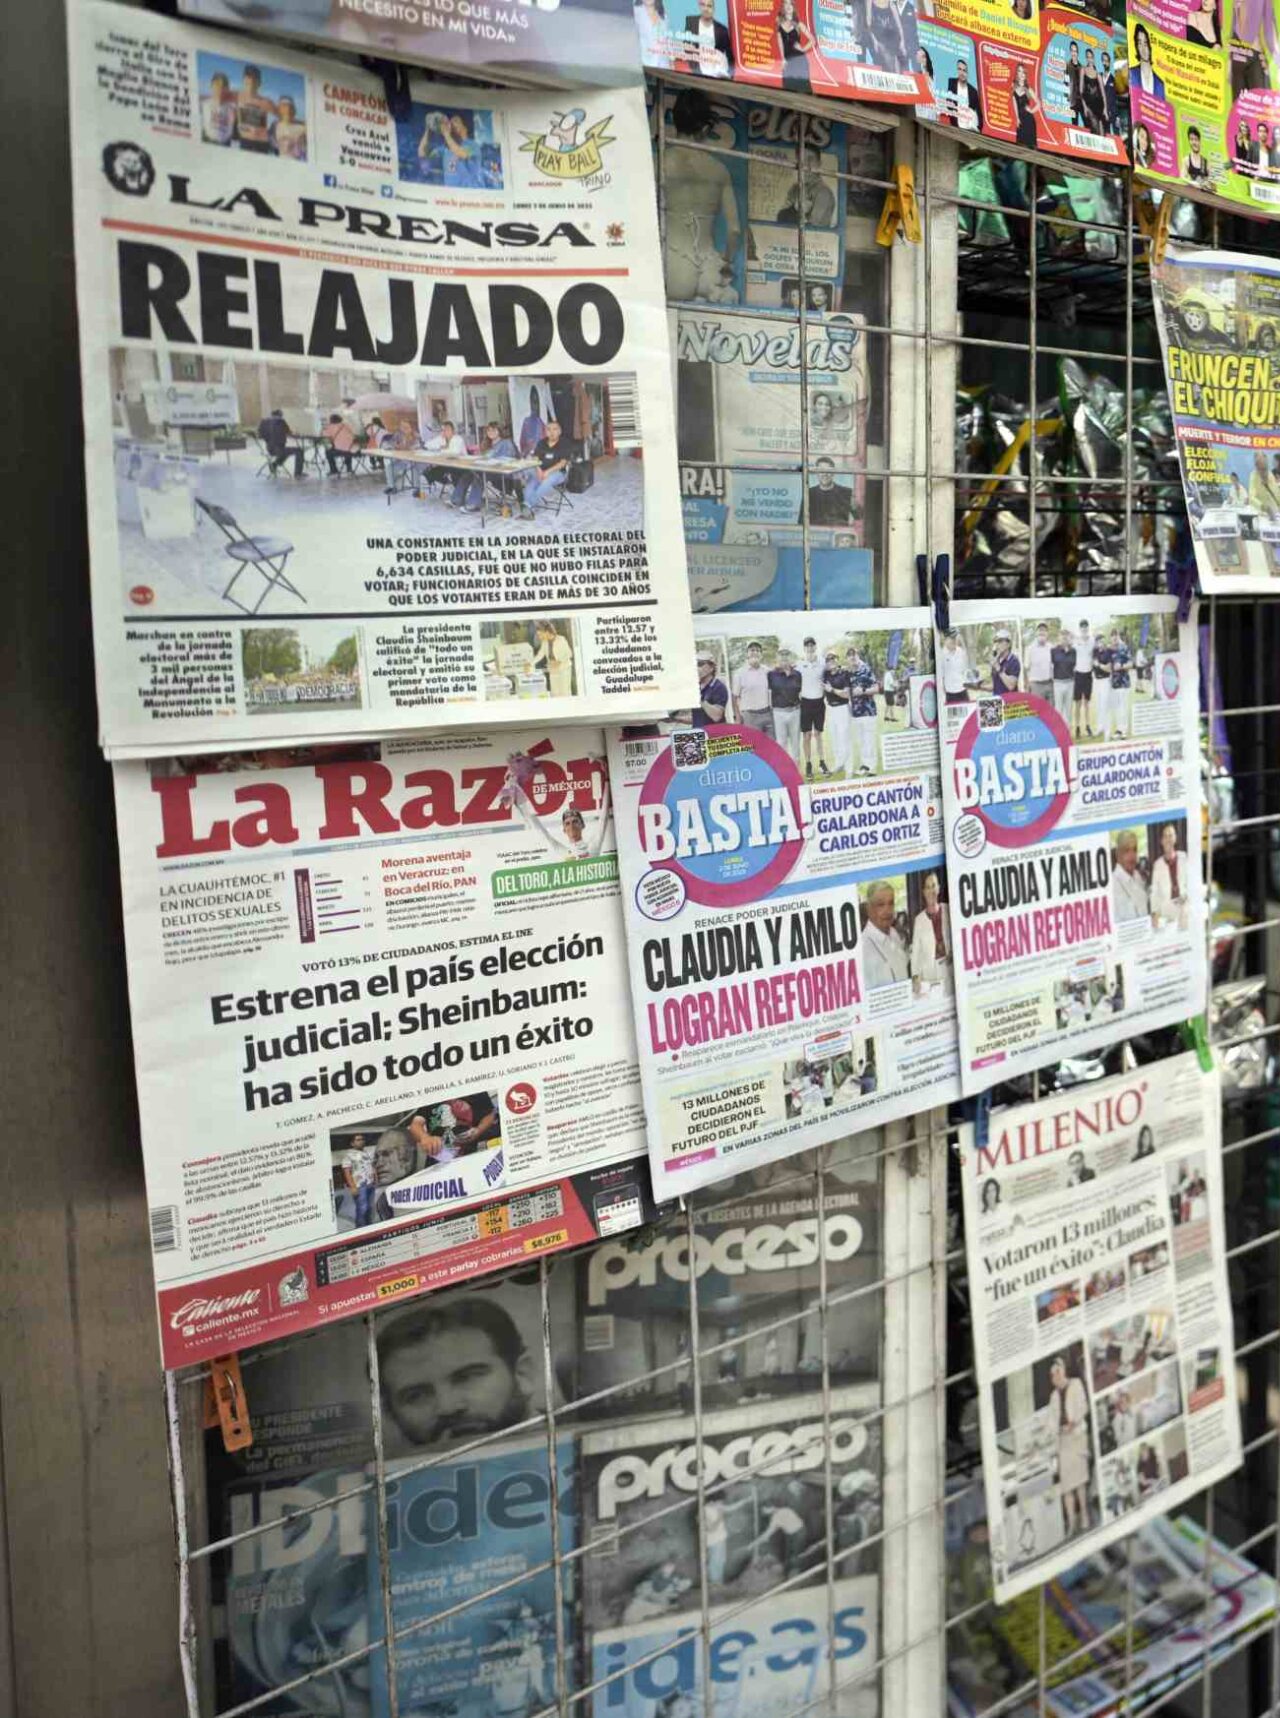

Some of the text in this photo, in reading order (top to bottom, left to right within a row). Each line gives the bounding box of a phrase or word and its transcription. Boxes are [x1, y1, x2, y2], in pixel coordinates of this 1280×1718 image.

[339, 0, 516, 44] NECESITO EN MI VIDA»
[457, 1, 492, 21] QUE
[495, 9, 530, 30] MÁS
[537, 147, 597, 172] PLAY BALL
[168, 174, 283, 222] LA
[298, 197, 596, 249] PRENSA
[117, 238, 625, 368] RELAJADO
[677, 319, 853, 372] Novelas
[1167, 345, 1271, 392] FRUNCEN
[1173, 380, 1201, 416] EL
[366, 530, 646, 550] UNA CONSTANTE JORNADA ELECTORAL DEL
[396, 544, 647, 563] PODER JUDICIAL, QUE INSTALARON
[376, 556, 649, 578] 6,634 CASILLAS, FUE QUE HUBO FILAS PARA
[363, 571, 633, 593] VOTAR; FUNCIONARIOS CASILLA COINCIDEN
[388, 582, 651, 607] QUE LOS VOTANTES ERAN MÁS 30 AÑOS
[416, 623, 472, 637] presidenta
[417, 633, 473, 645] Sheinbaum
[606, 673, 654, 685] Guadalupe
[152, 706, 214, 720] Revolución
[395, 696, 445, 708] República
[996, 728, 1037, 747] diario
[1077, 746, 1164, 772] GRUPO CANTÓN
[533, 779, 593, 797] DE MÉXICO
[699, 765, 752, 787] diario
[1081, 769, 1150, 788] GALARDONA
[150, 739, 608, 858] La Razón
[811, 783, 924, 817] GRUPO CANTÓN
[1082, 780, 1162, 806] CARLOS ORTIZ
[639, 781, 816, 865] BASTA!
[816, 807, 921, 834] GALARDONA A
[819, 823, 921, 854] CARLOS ORTIZ
[381, 850, 472, 869] Morena aventaja
[273, 870, 286, 882] #1
[384, 885, 413, 898] Boca
[453, 876, 478, 889] PAN
[495, 876, 512, 894] DEL
[959, 847, 1111, 918] CLAUDIA Y AMLO
[161, 901, 282, 928] DELITOS SEXUALES
[179, 891, 255, 911] INCIDENCIA
[694, 899, 811, 930] RENACE PODER JUDICIAL
[642, 902, 859, 993] CLAUDIA Y AMLO
[961, 896, 1113, 971] LOGRAN REFORMA
[301, 927, 535, 974] VOTÓ 13% CIUDADANOS, ESTIMA INE
[210, 931, 605, 1026] Estrena el país elección
[647, 957, 862, 1055] LOGRAN REFORMA
[988, 1009, 1039, 1028] CIUDADANOS
[240, 977, 589, 1074] judicial; Sheinbaum:
[242, 1013, 594, 1113] ha sido todo un éxito
[690, 1095, 761, 1121] CIUDADANOS
[692, 1085, 751, 1108] MILLONES
[671, 1120, 760, 1153] FUTURO DEL PJF
[687, 1111, 752, 1135] DECIDIERON
[976, 1089, 1143, 1177] MILENIO
[390, 1177, 468, 1205] PODER JUDICIAL
[588, 1214, 863, 1307] proceso
[983, 1221, 1081, 1275] Votaron 13
[331, 1290, 377, 1312] apuestas
[379, 1279, 416, 1295] $1,000
[427, 1269, 449, 1283] este
[450, 1259, 479, 1276] parlay
[170, 1288, 261, 1330] Caliente
[195, 1306, 260, 1334] caliente.mx
[597, 1418, 869, 1520] proceso
[606, 1606, 868, 1709] ideas
